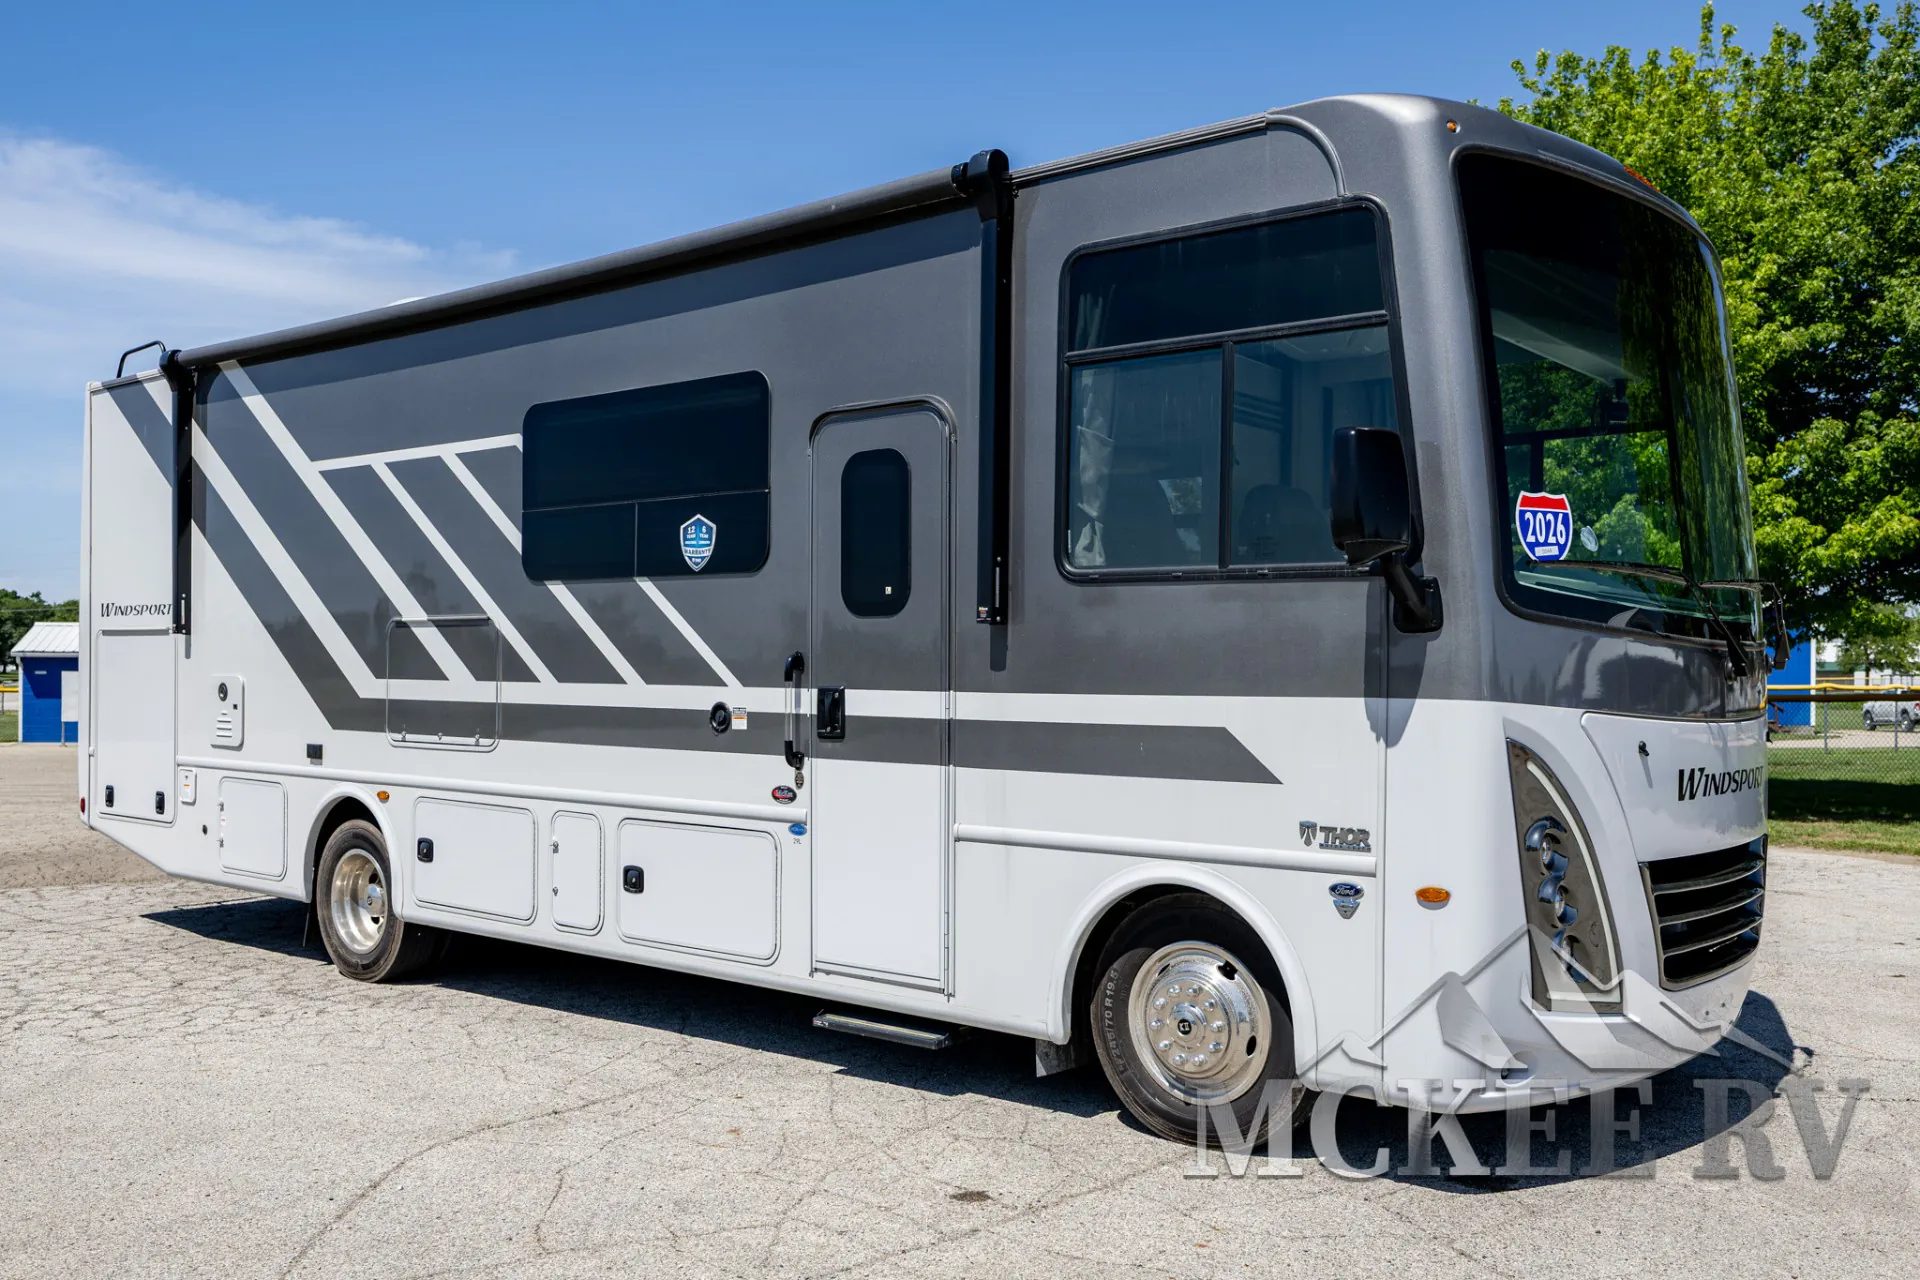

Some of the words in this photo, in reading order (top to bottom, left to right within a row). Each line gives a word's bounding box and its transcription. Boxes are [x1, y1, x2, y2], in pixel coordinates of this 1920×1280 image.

[687, 525, 696, 534] 12
[1524, 511, 1566, 545] 2026
[101, 602, 173, 618] WINDSPORT
[1677, 766, 1764, 802] WINDSPORT
[1319, 825, 1371, 848] THOR
[1335, 884, 1356, 896] Ford
